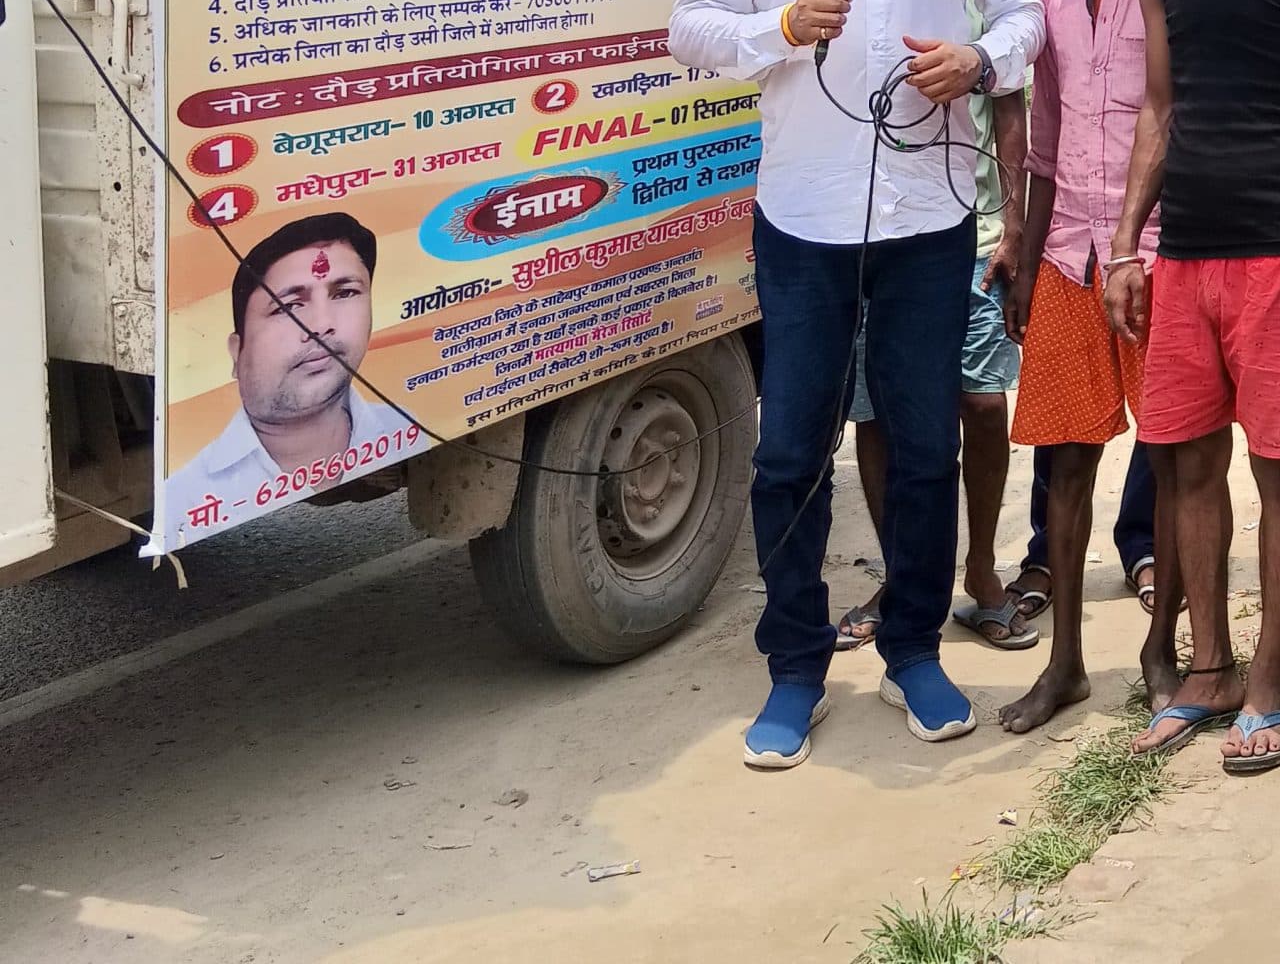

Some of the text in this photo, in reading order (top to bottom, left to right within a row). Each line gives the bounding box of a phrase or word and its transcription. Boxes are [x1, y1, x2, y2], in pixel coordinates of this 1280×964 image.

[209, 27, 227, 43] 5.
[234, 17, 298, 40] अधिक
[301, 6, 378, 32] जानकारी
[382, 3, 399, 23] के
[403, 1, 440, 24] लिए
[209, 11, 594, 72] 6. प्रत्येक जिला का दौड़ उसी जिले में आयोजित होगा।
[310, 45, 586, 103] दौड़ प्रतियोगिता का
[413, 98, 516, 130] 10 अगस्त
[545, 85, 566, 108] 2
[672, 104, 688, 125] 07
[210, 140, 233, 168] 1
[393, 142, 501, 178] 31 अगस्त
[631, 150, 679, 179] प्रथम
[208, 192, 237, 222] 4
[493, 183, 586, 228] ईनाम
[632, 167, 714, 204] द्वितिय से
[512, 198, 729, 291] सुशील कुमार यादव उर्फ
[434, 260, 662, 341] बेगूसराय जिले के साहेबपुर कमाल प्रखण्ड
[441, 267, 696, 358] शालीग्राम में इनका जन्मस्थान एवं सहरसा जिला
[406, 279, 704, 391] इनका कर्मस्थल रहा है यहाँ इनके कई प्रकार के बिजनेस
[464, 326, 660, 406] एवं एवं मुख्य
[466, 324, 718, 427] इस प्रतियोगिता में के द्वारा नियम
[495, 352, 532, 376] जिनमें
[256, 424, 420, 505] 6205602019
